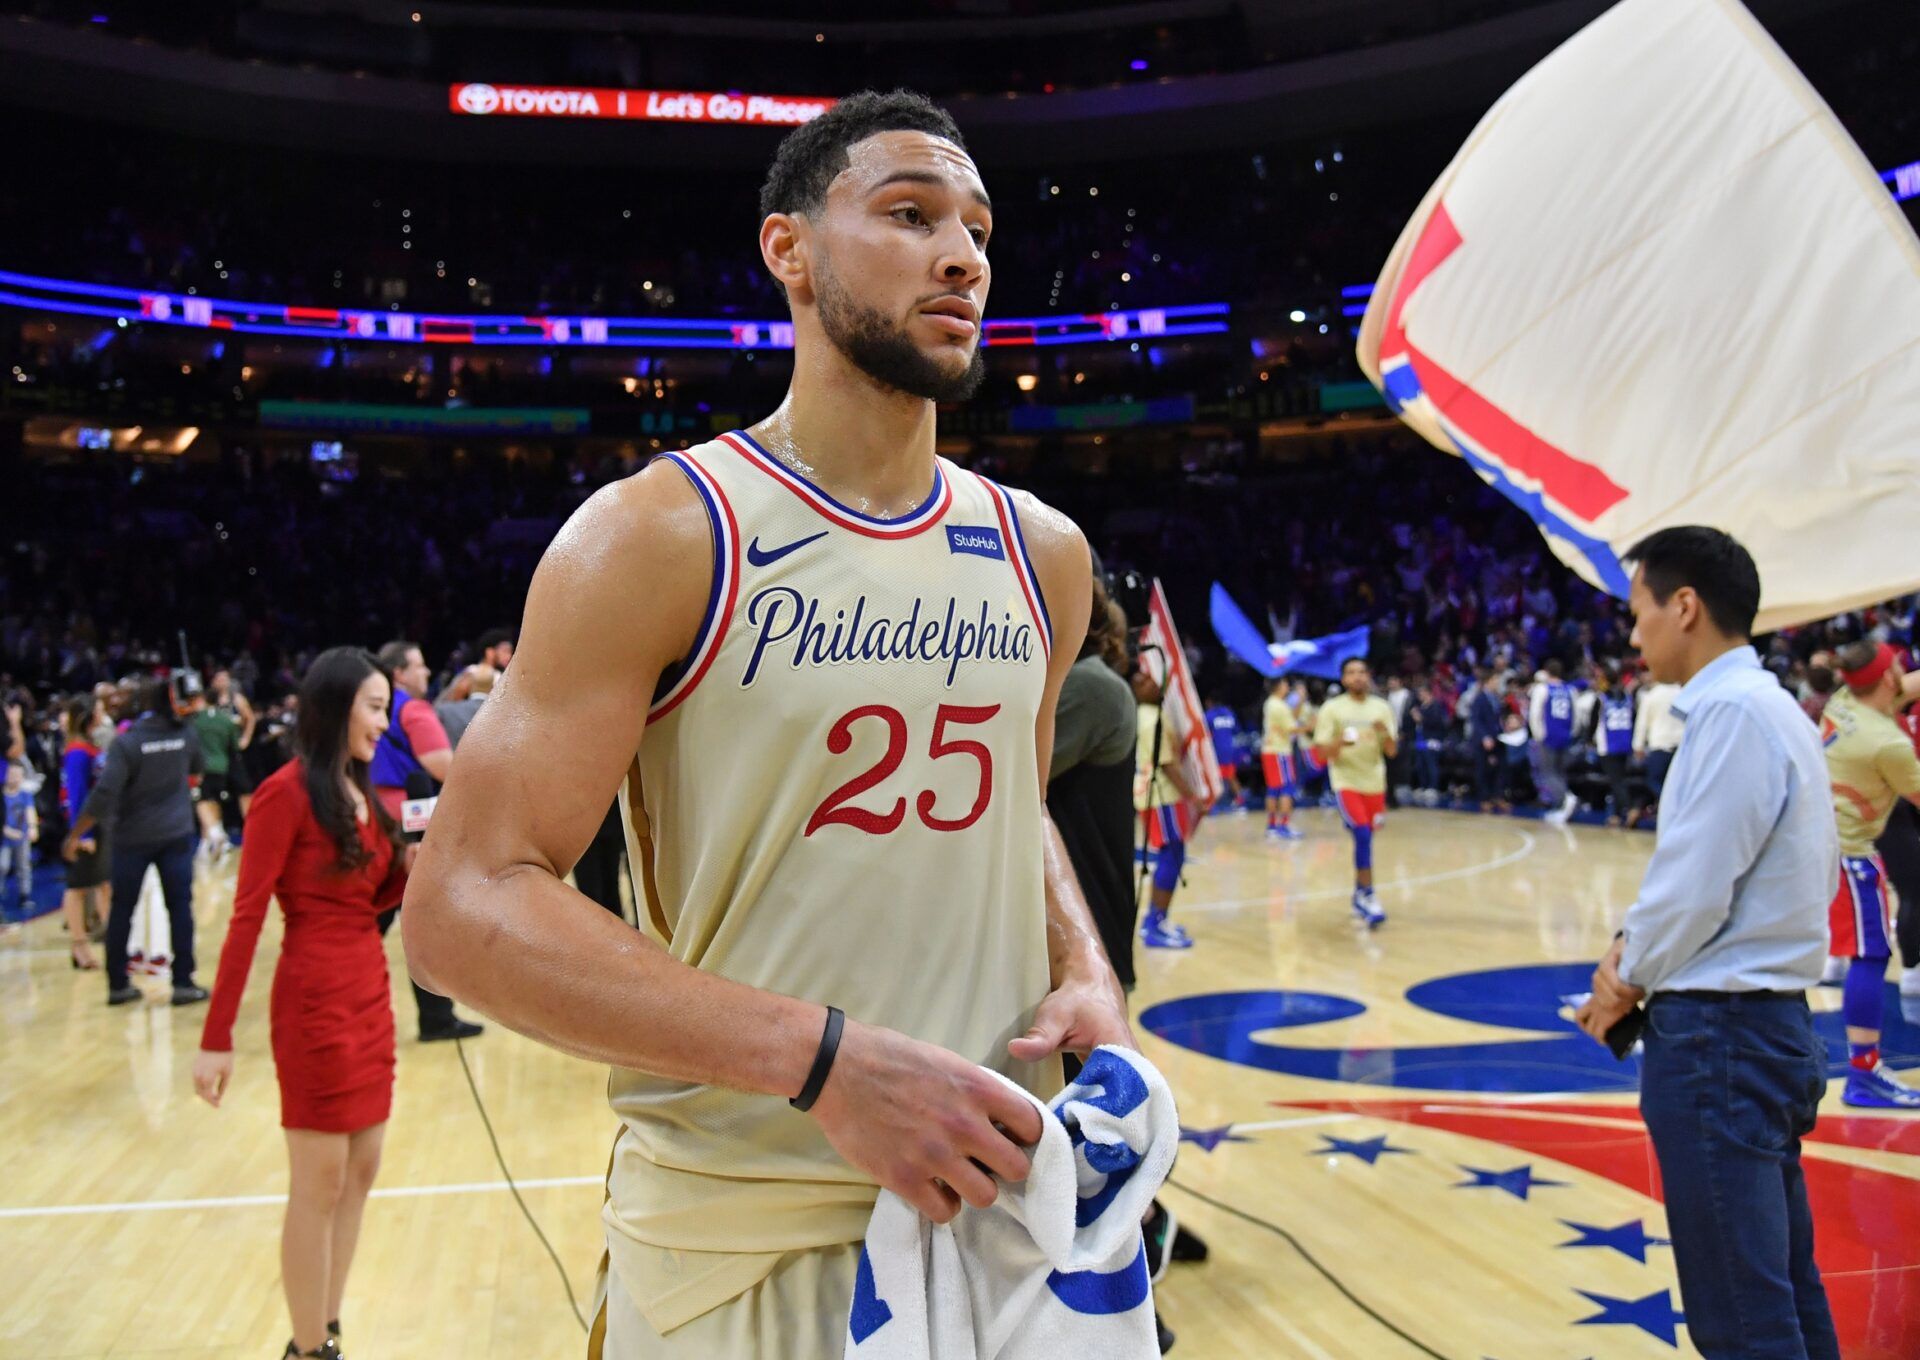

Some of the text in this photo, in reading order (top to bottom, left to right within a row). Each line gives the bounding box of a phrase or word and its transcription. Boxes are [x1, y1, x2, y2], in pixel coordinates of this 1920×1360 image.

[499, 89, 600, 115] TOYOTA
[645, 91, 704, 119] Let's
[707, 94, 745, 120] Go
[953, 533, 998, 551] StubHub
[739, 586, 1034, 688] Philadelphia
[804, 703, 1001, 837] 25
